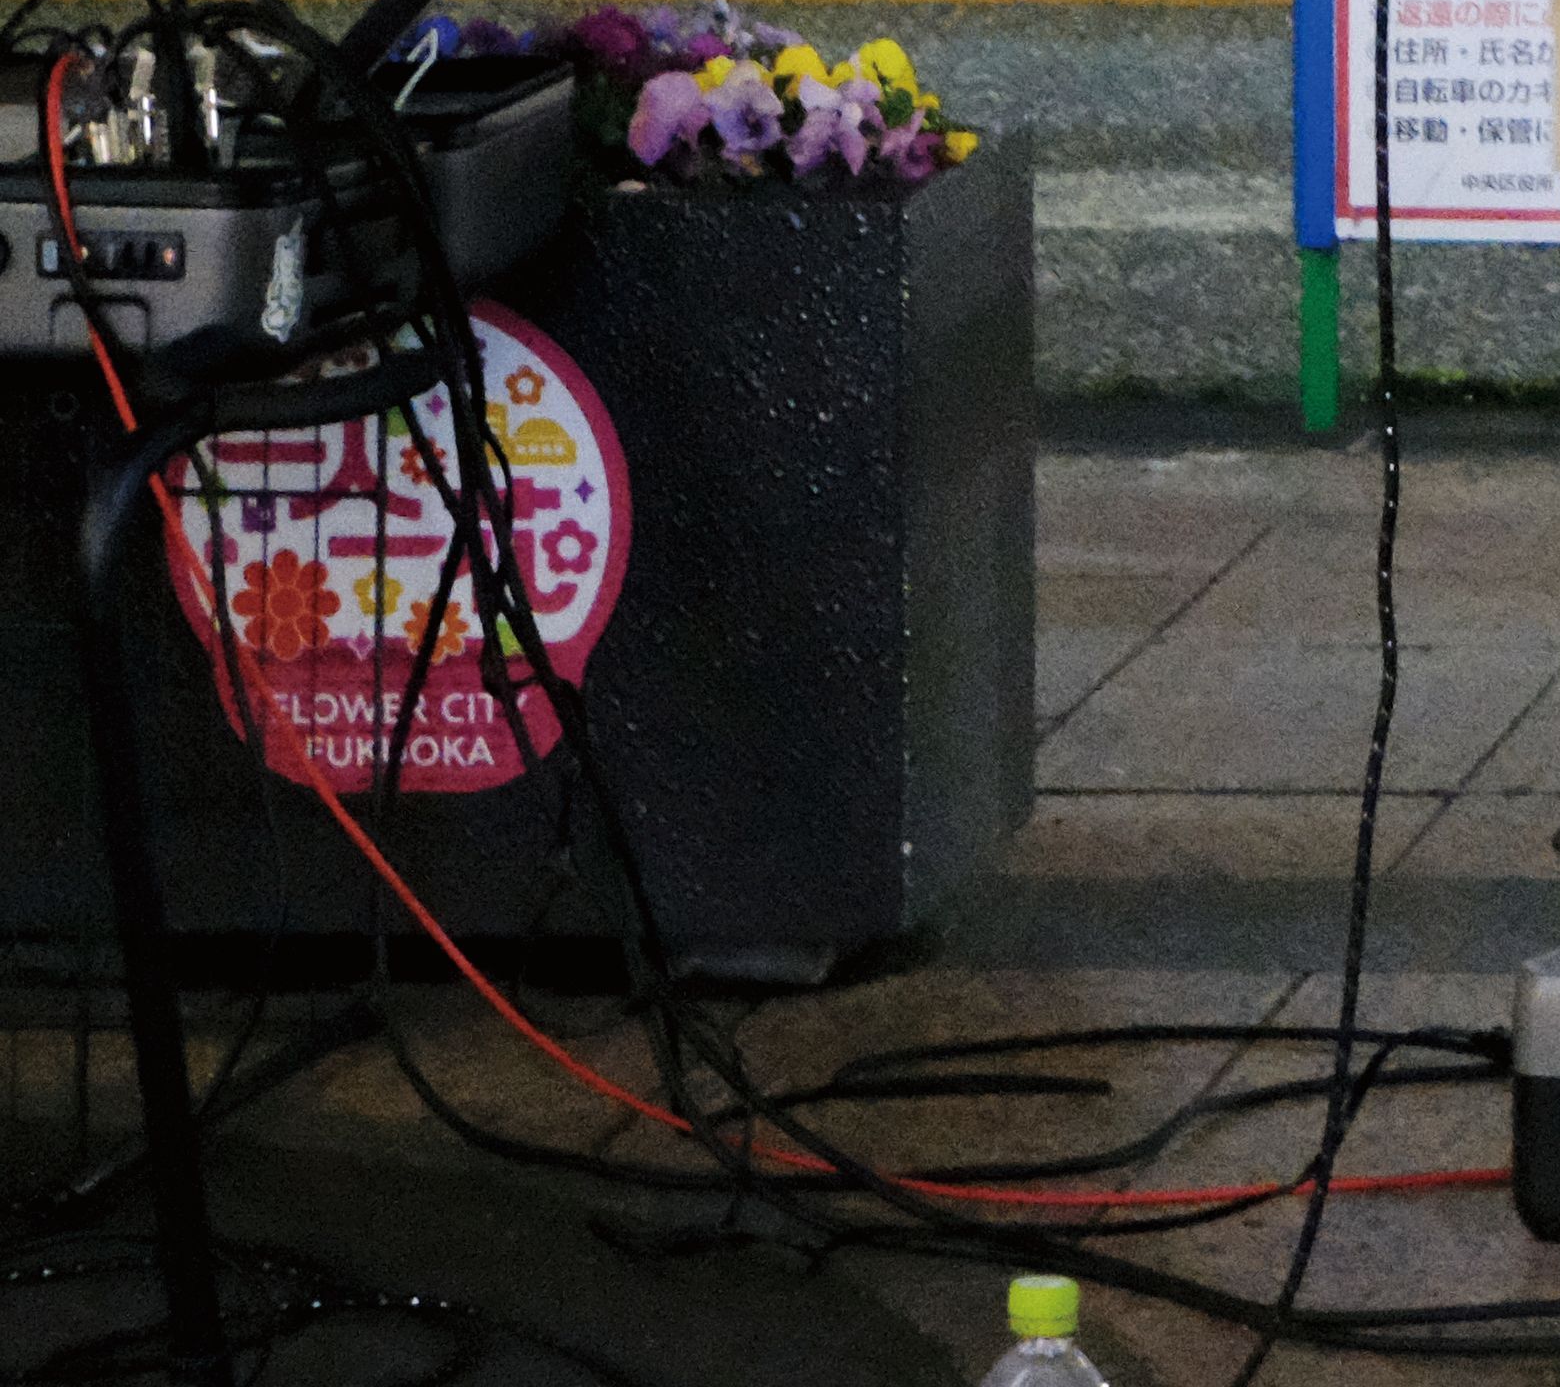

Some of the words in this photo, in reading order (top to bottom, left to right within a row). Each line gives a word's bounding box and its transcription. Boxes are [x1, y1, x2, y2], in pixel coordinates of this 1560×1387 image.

[1396, 0, 1553, 27] 返還の際に
[440, 691, 528, 725] CIT
